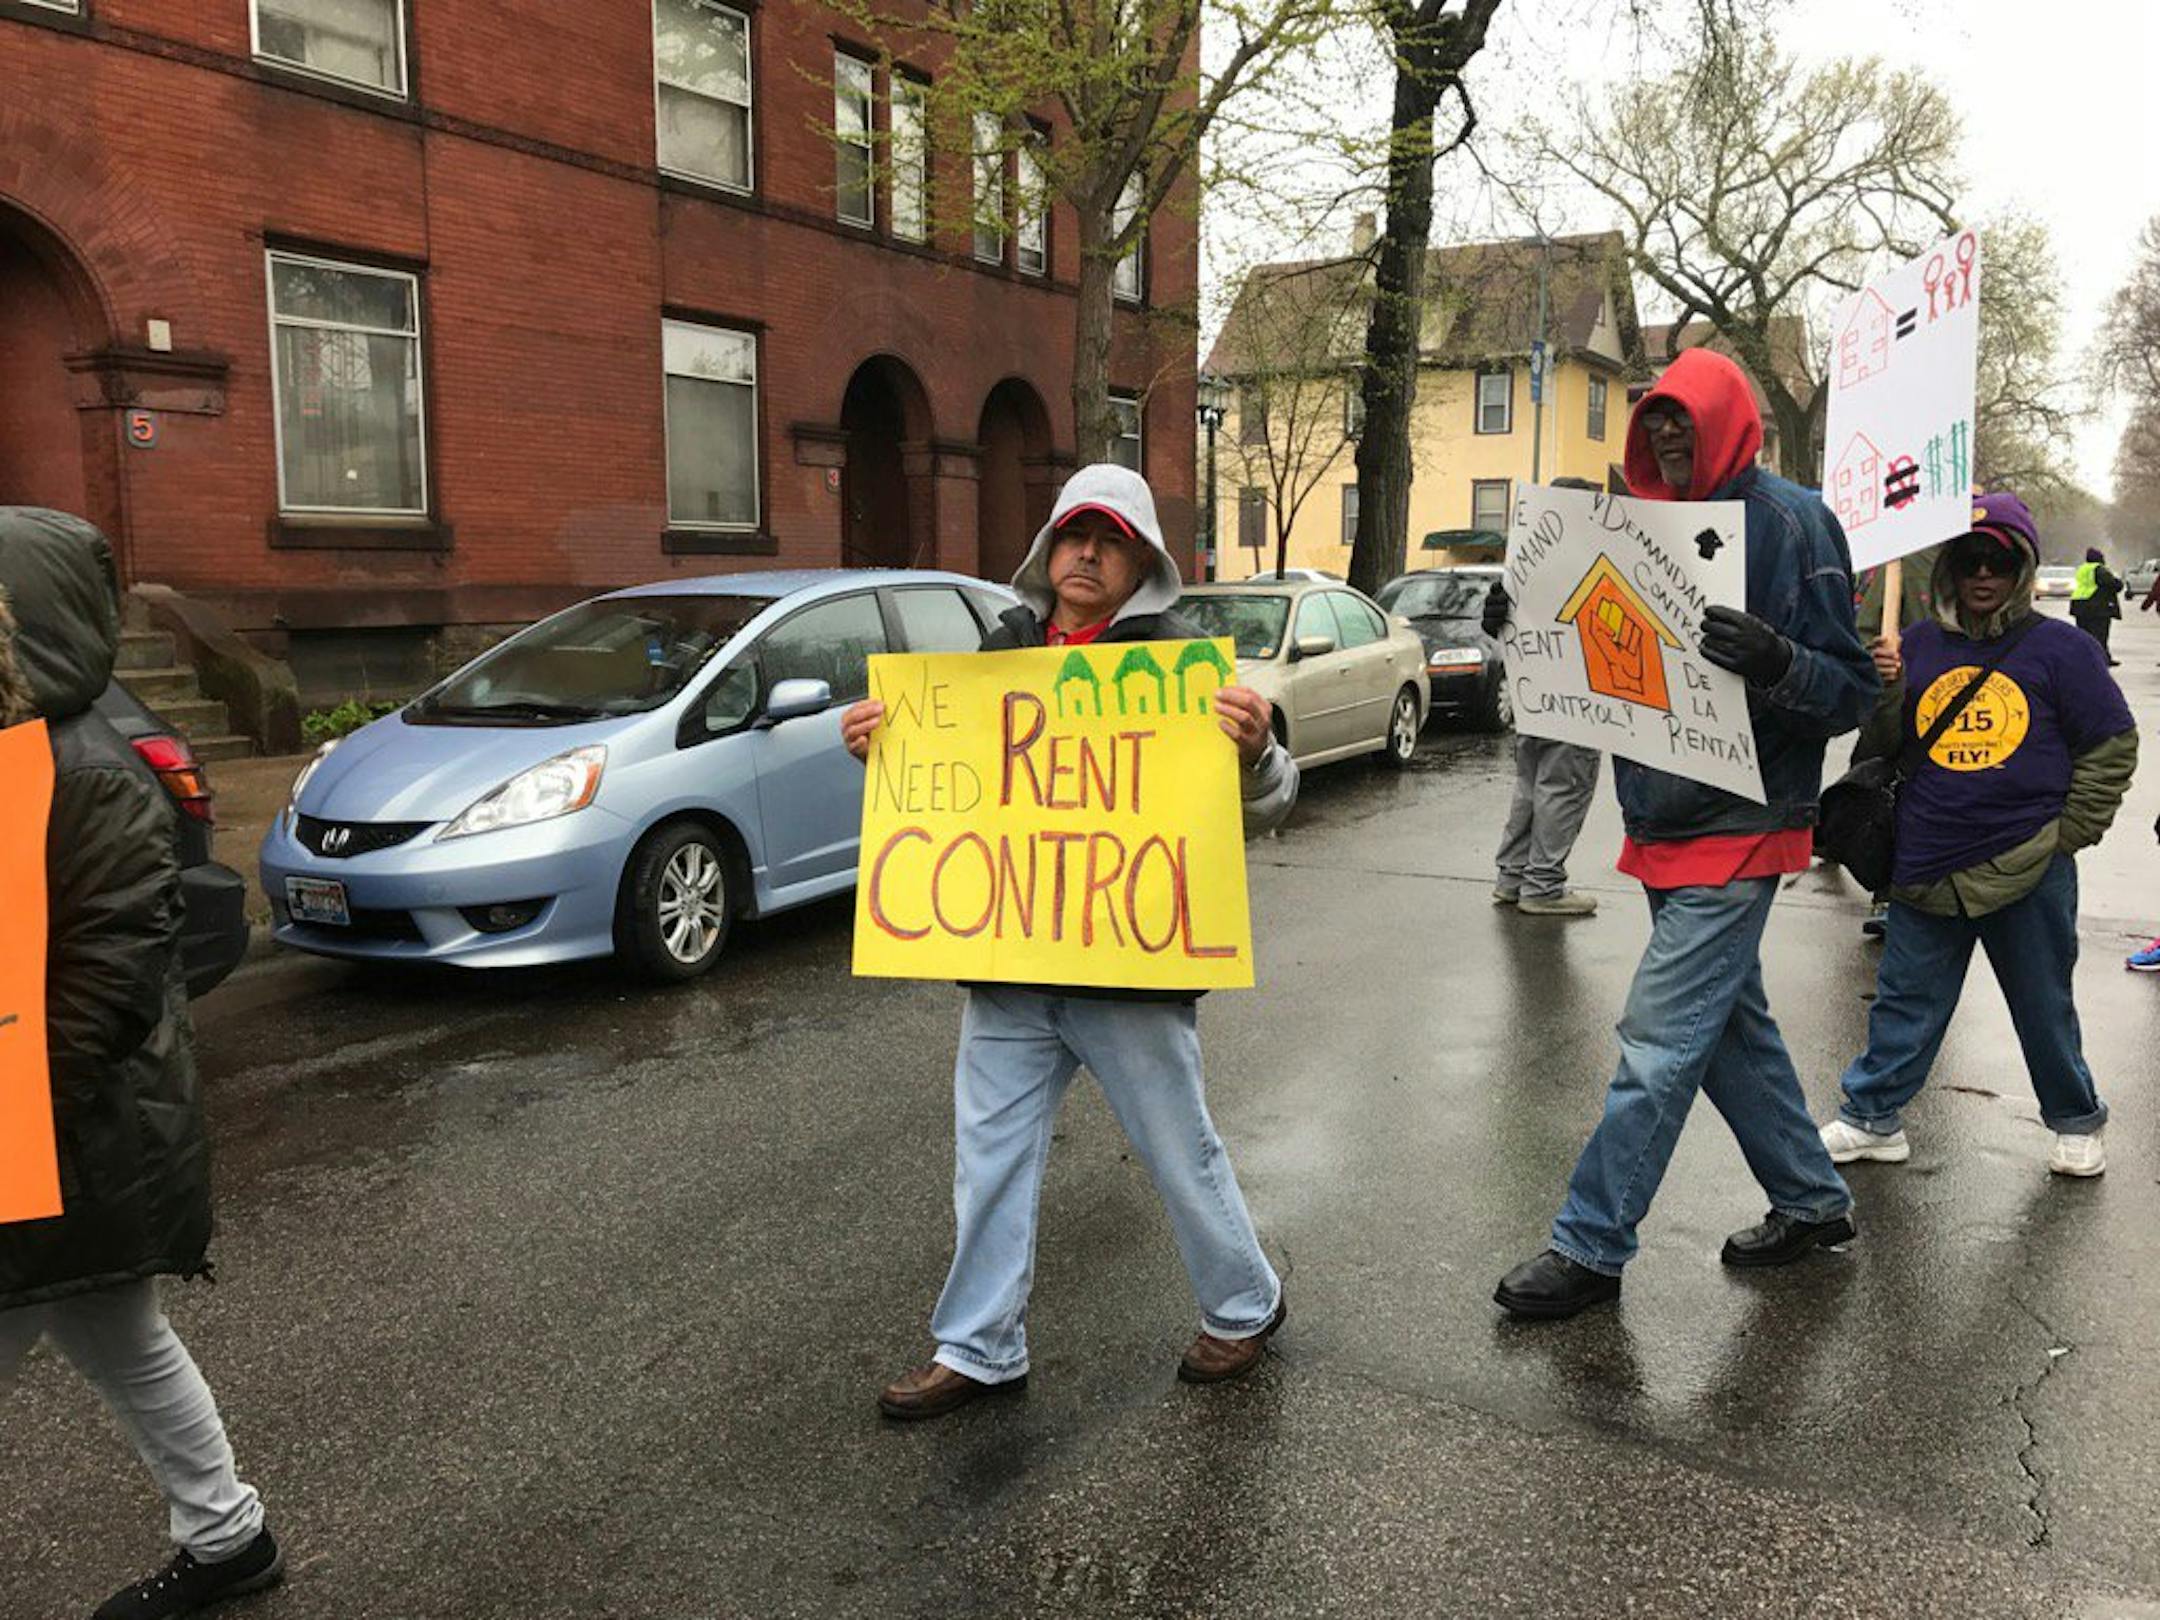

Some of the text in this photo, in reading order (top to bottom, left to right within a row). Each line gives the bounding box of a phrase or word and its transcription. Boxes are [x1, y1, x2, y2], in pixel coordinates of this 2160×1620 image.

[133, 414, 153, 441] 5
[1504, 620, 1565, 661] RENT
[876, 660, 957, 729] WE
[1684, 663, 1711, 691] DE
[1517, 677, 1635, 737] CONTROL!
[1692, 696, 1717, 723] LA
[1000, 691, 1156, 814] RENT
[1662, 713, 1754, 770] RENTA!
[1948, 750, 1989, 764] FLY!
[873, 739, 981, 813] NEED
[869, 826, 1238, 957] CONTROL
